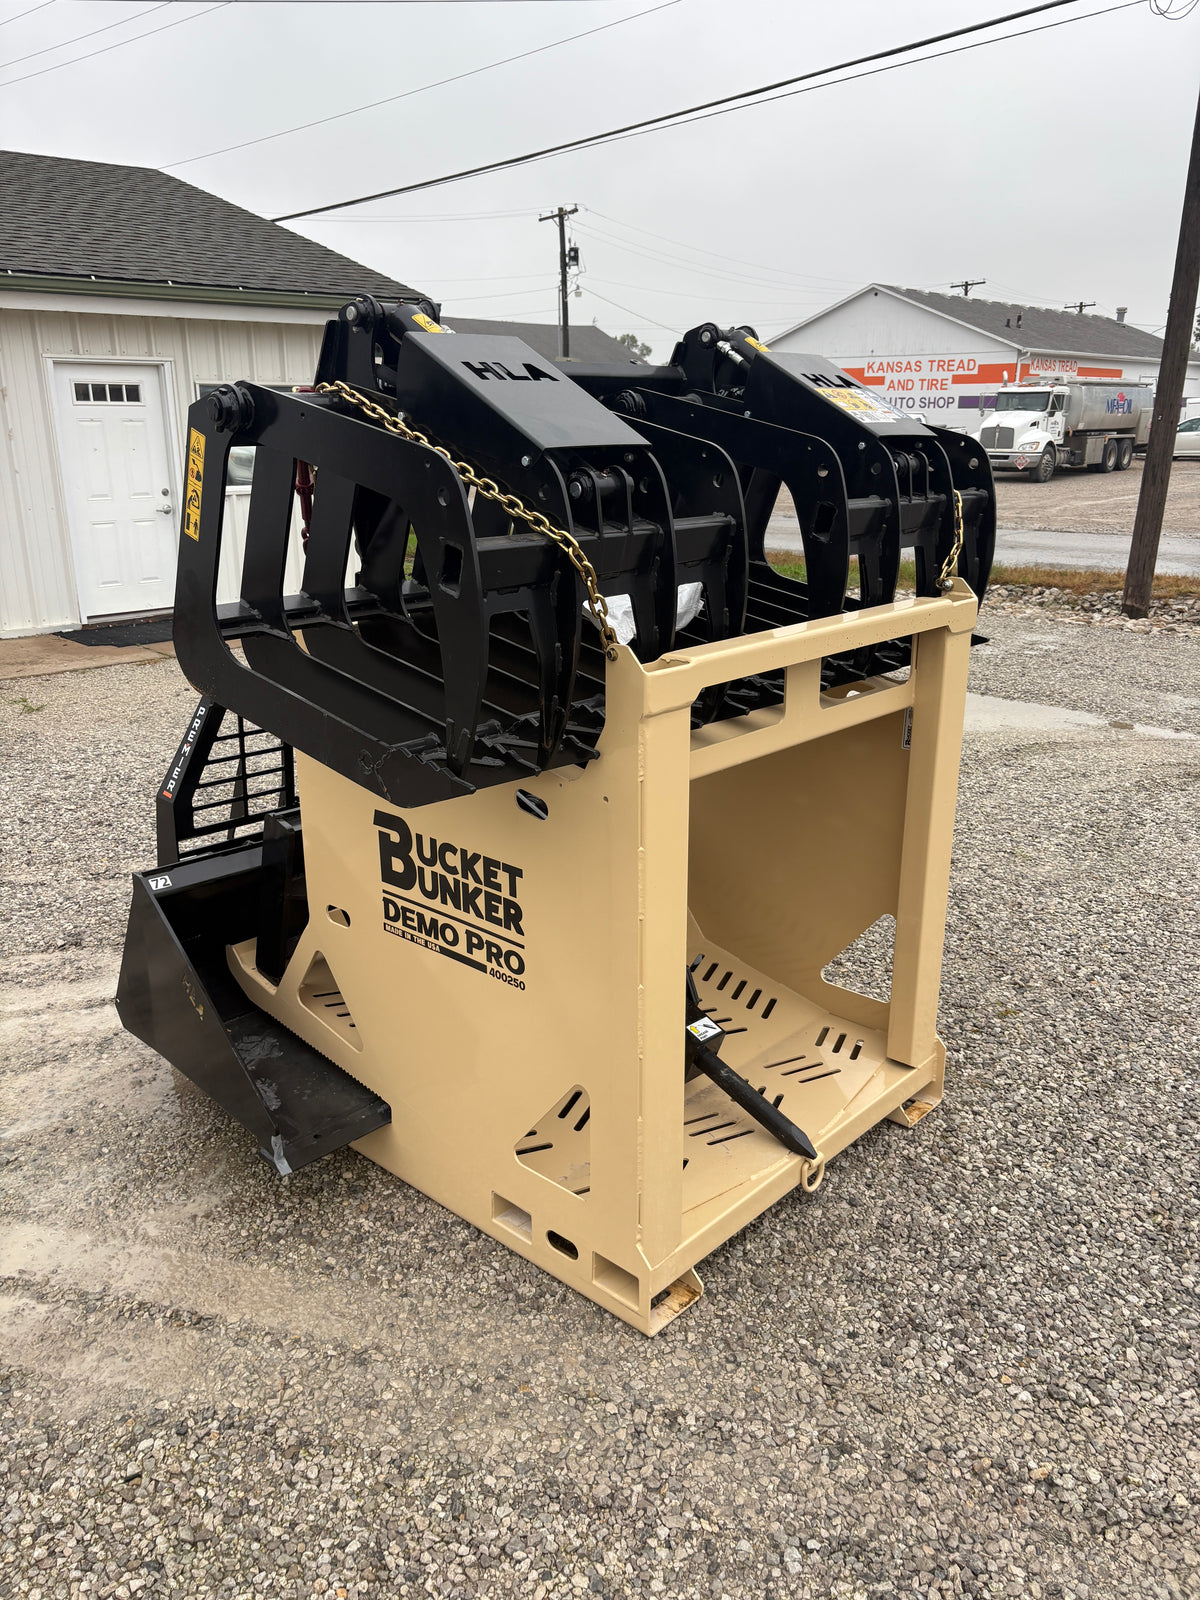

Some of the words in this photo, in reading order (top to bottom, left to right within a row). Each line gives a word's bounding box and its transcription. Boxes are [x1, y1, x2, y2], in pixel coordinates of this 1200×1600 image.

[461, 361, 560, 381] HLA
[866, 361, 922, 374] KANSAS
[928, 359, 976, 373] TREAD
[1030, 358, 1057, 372] KANSAS
[1058, 360, 1078, 373] TREAD
[800, 373, 862, 389] HLA
[886, 379, 915, 391] AND
[919, 378, 949, 391] TIRE
[883, 397, 916, 409] UTO
[918, 396, 955, 409] SHOP
[166, 706, 206, 791] PREMIER
[373, 809, 524, 898] BUCKET
[151, 876, 170, 889] 72
[382, 896, 460, 947] DEMO
[465, 929, 526, 976] PRO
[385, 924, 403, 937] MADE
[404, 931, 412, 940] IN
[413, 936, 426, 946] THE
[427, 941, 441, 953] USA
[489, 967, 526, 991] 400250
